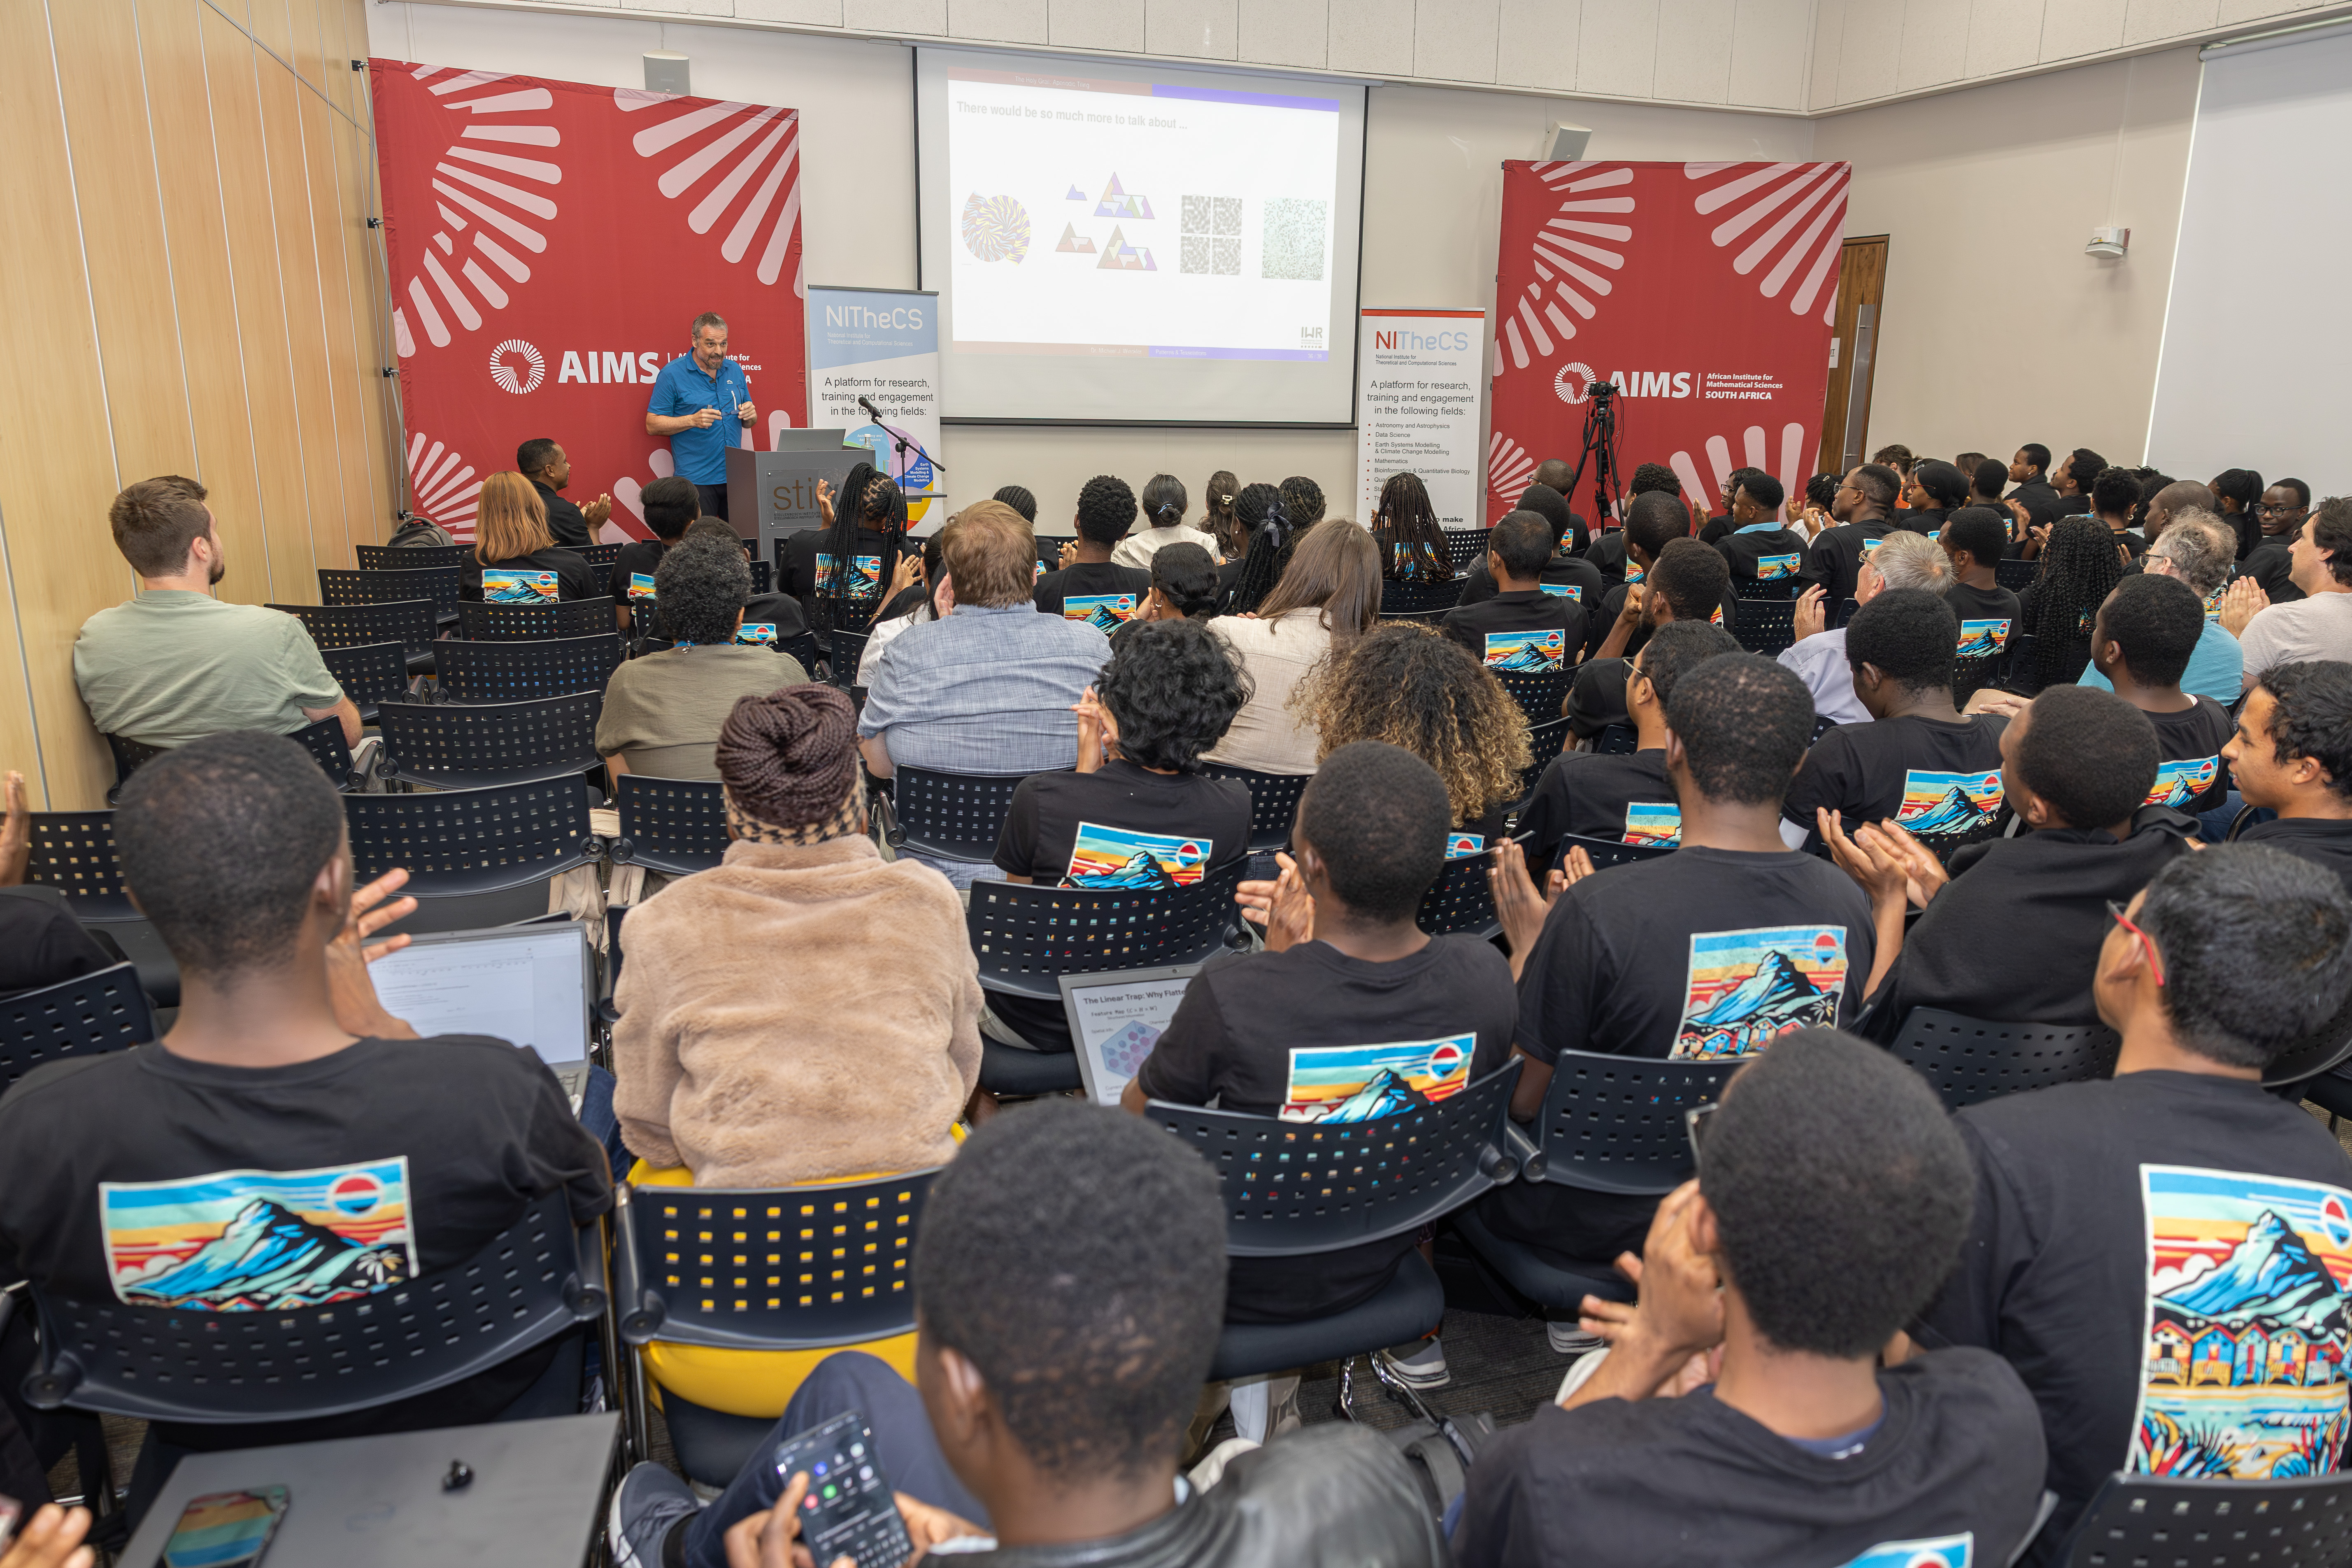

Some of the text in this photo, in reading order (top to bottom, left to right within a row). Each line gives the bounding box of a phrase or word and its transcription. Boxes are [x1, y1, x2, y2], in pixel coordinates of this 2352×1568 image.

[957, 101, 987, 114] There
[991, 106, 1021, 116] would
[1025, 107, 1037, 117] be
[1041, 110, 1053, 119] so
[1056, 110, 1083, 121] much
[1087, 113, 1112, 123] more
[1115, 114, 1125, 124] to
[1128, 115, 1145, 126] talk
[1149, 116, 1176, 128] about
[826, 305, 923, 330] NITheCS
[1301, 326, 1322, 338] IWR
[1376, 331, 1468, 351] NITheCS
[558, 351, 660, 384] AIMS
[825, 377, 929, 388] A platform for research,
[1380, 381, 1414, 390] platform
[1431, 382, 1470, 391] research,
[1609, 371, 1691, 398] AIMS
[821, 392, 855, 402] training
[879, 393, 933, 403] engagement
[1367, 393, 1398, 403] training
[1421, 395, 1474, 404] engagement
[831, 407, 838, 415] in
[842, 407, 855, 415] the
[900, 407, 926, 415] fields:
[1401, 407, 1438, 416] following
[1441, 407, 1466, 415] fields:
